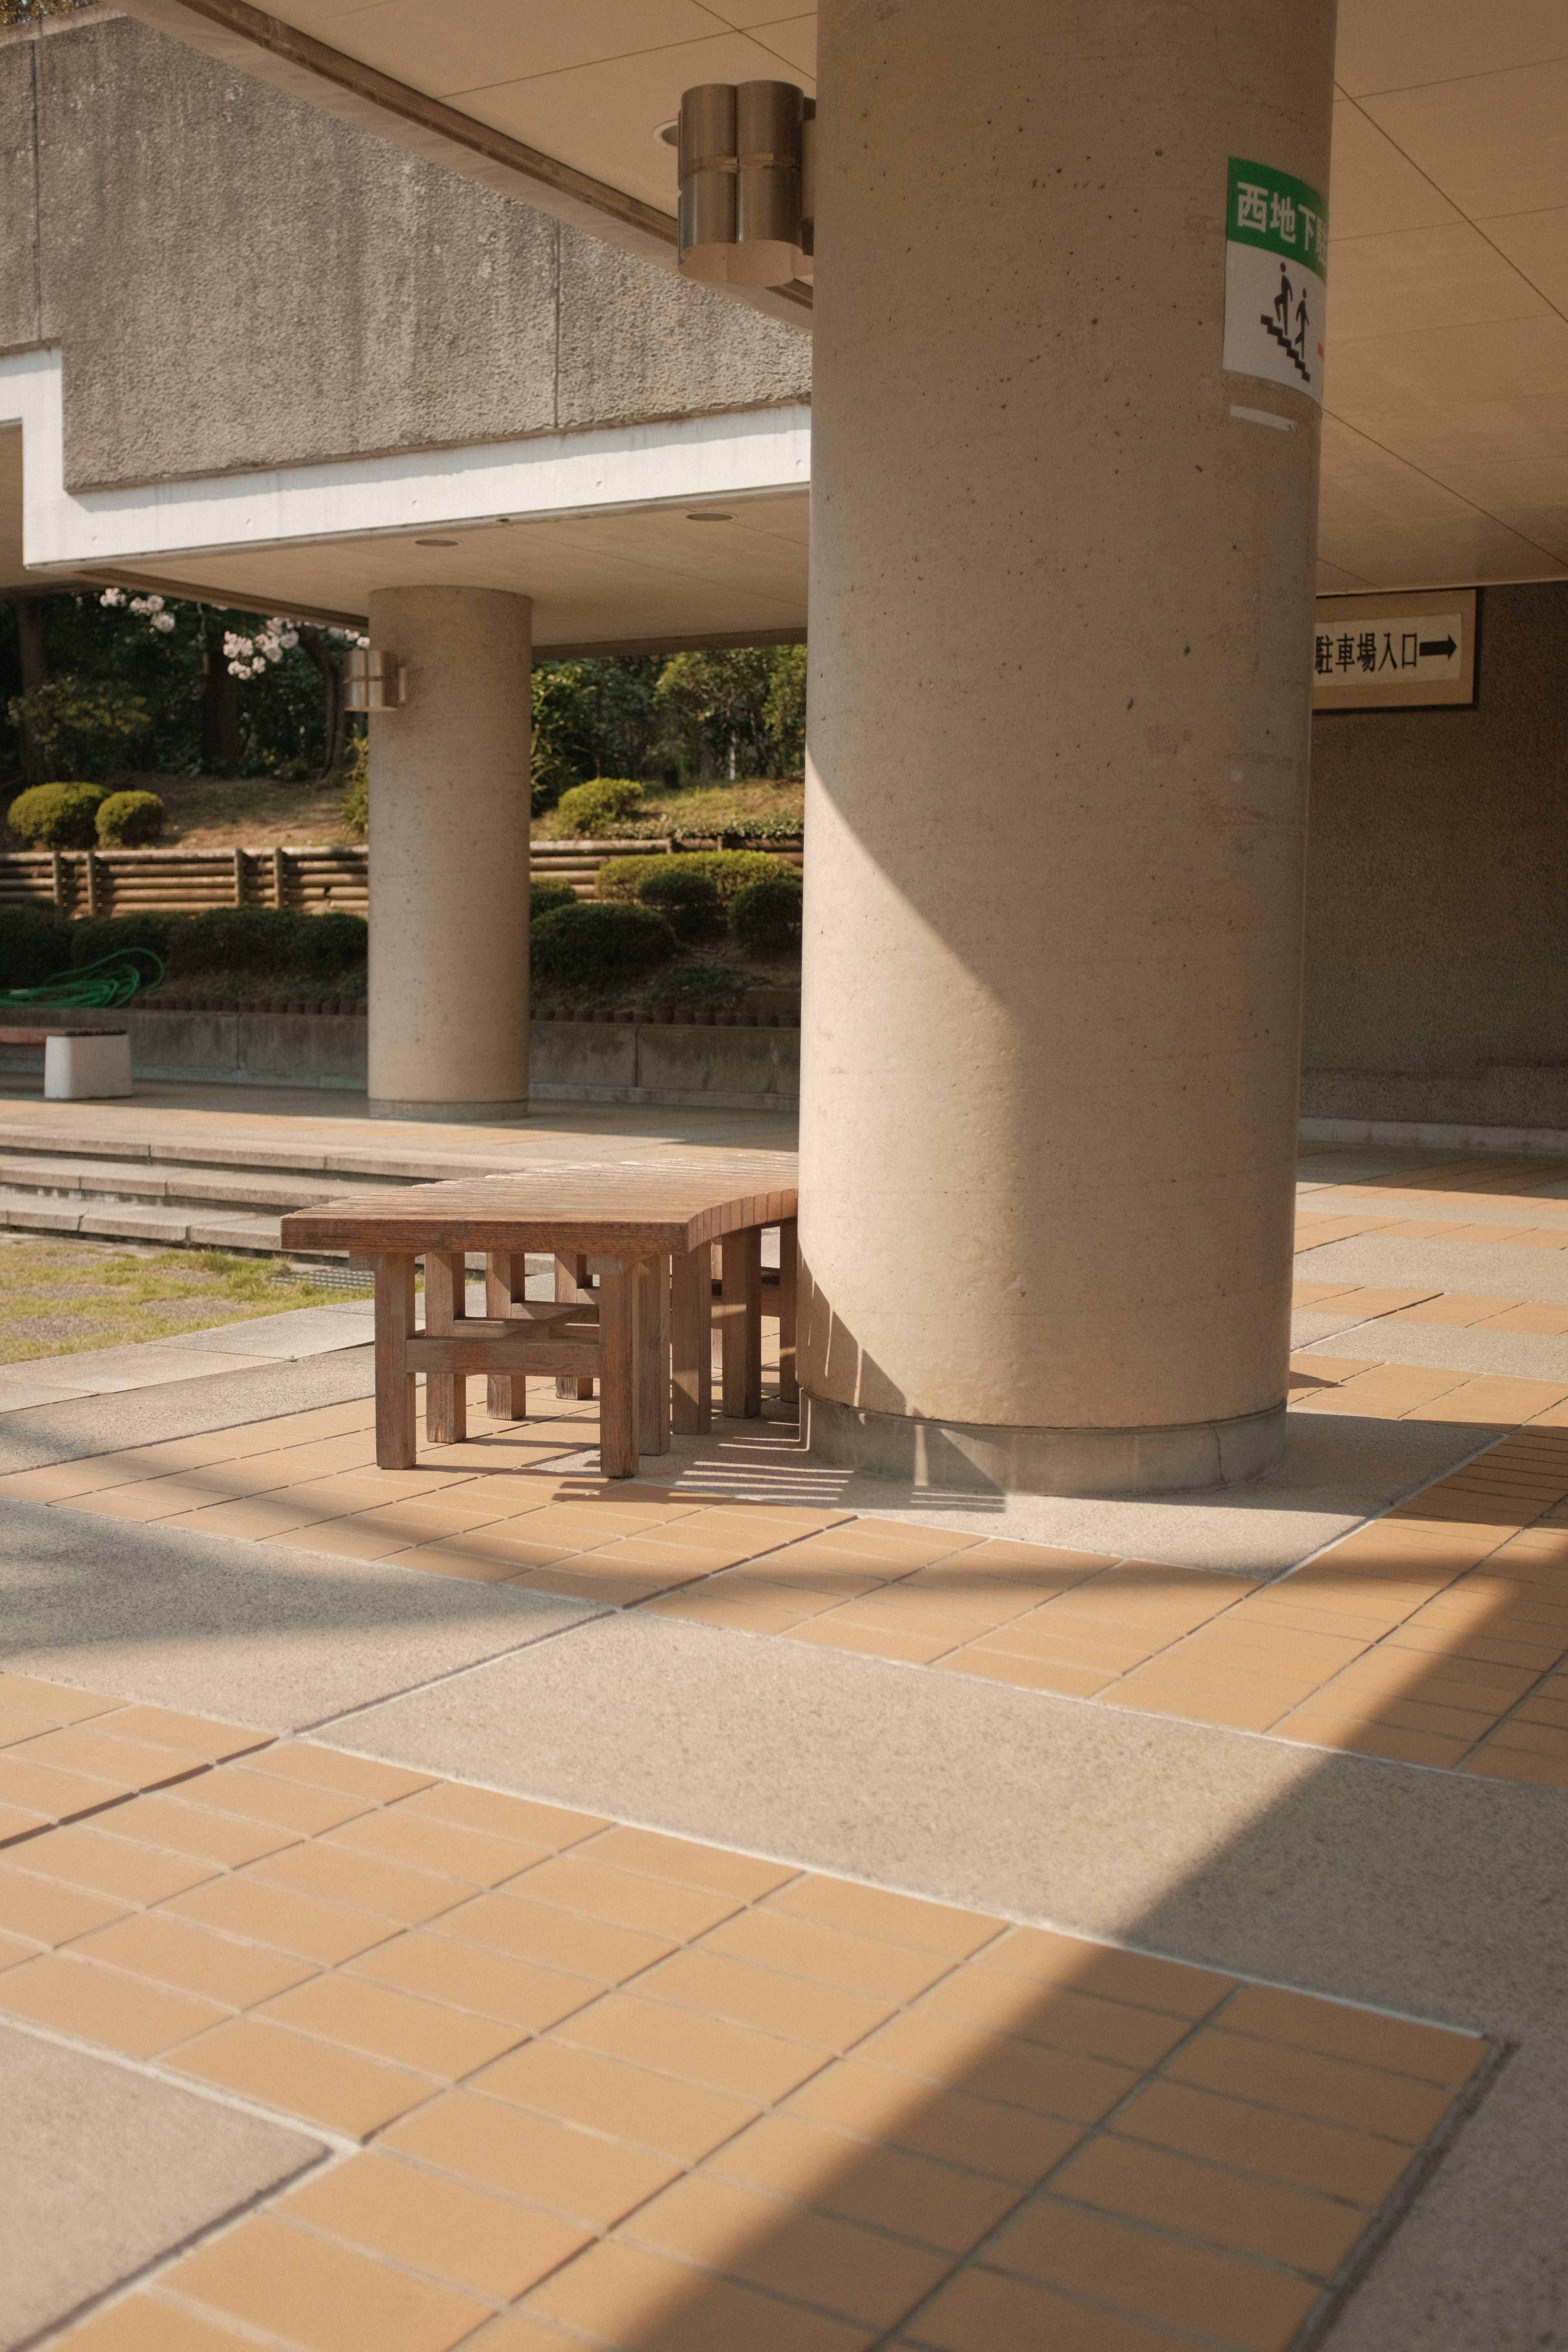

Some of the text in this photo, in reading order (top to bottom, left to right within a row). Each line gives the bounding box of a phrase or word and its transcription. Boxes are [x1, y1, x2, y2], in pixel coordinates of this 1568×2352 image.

[1315, 632, 1417, 674] 駐車場入口
